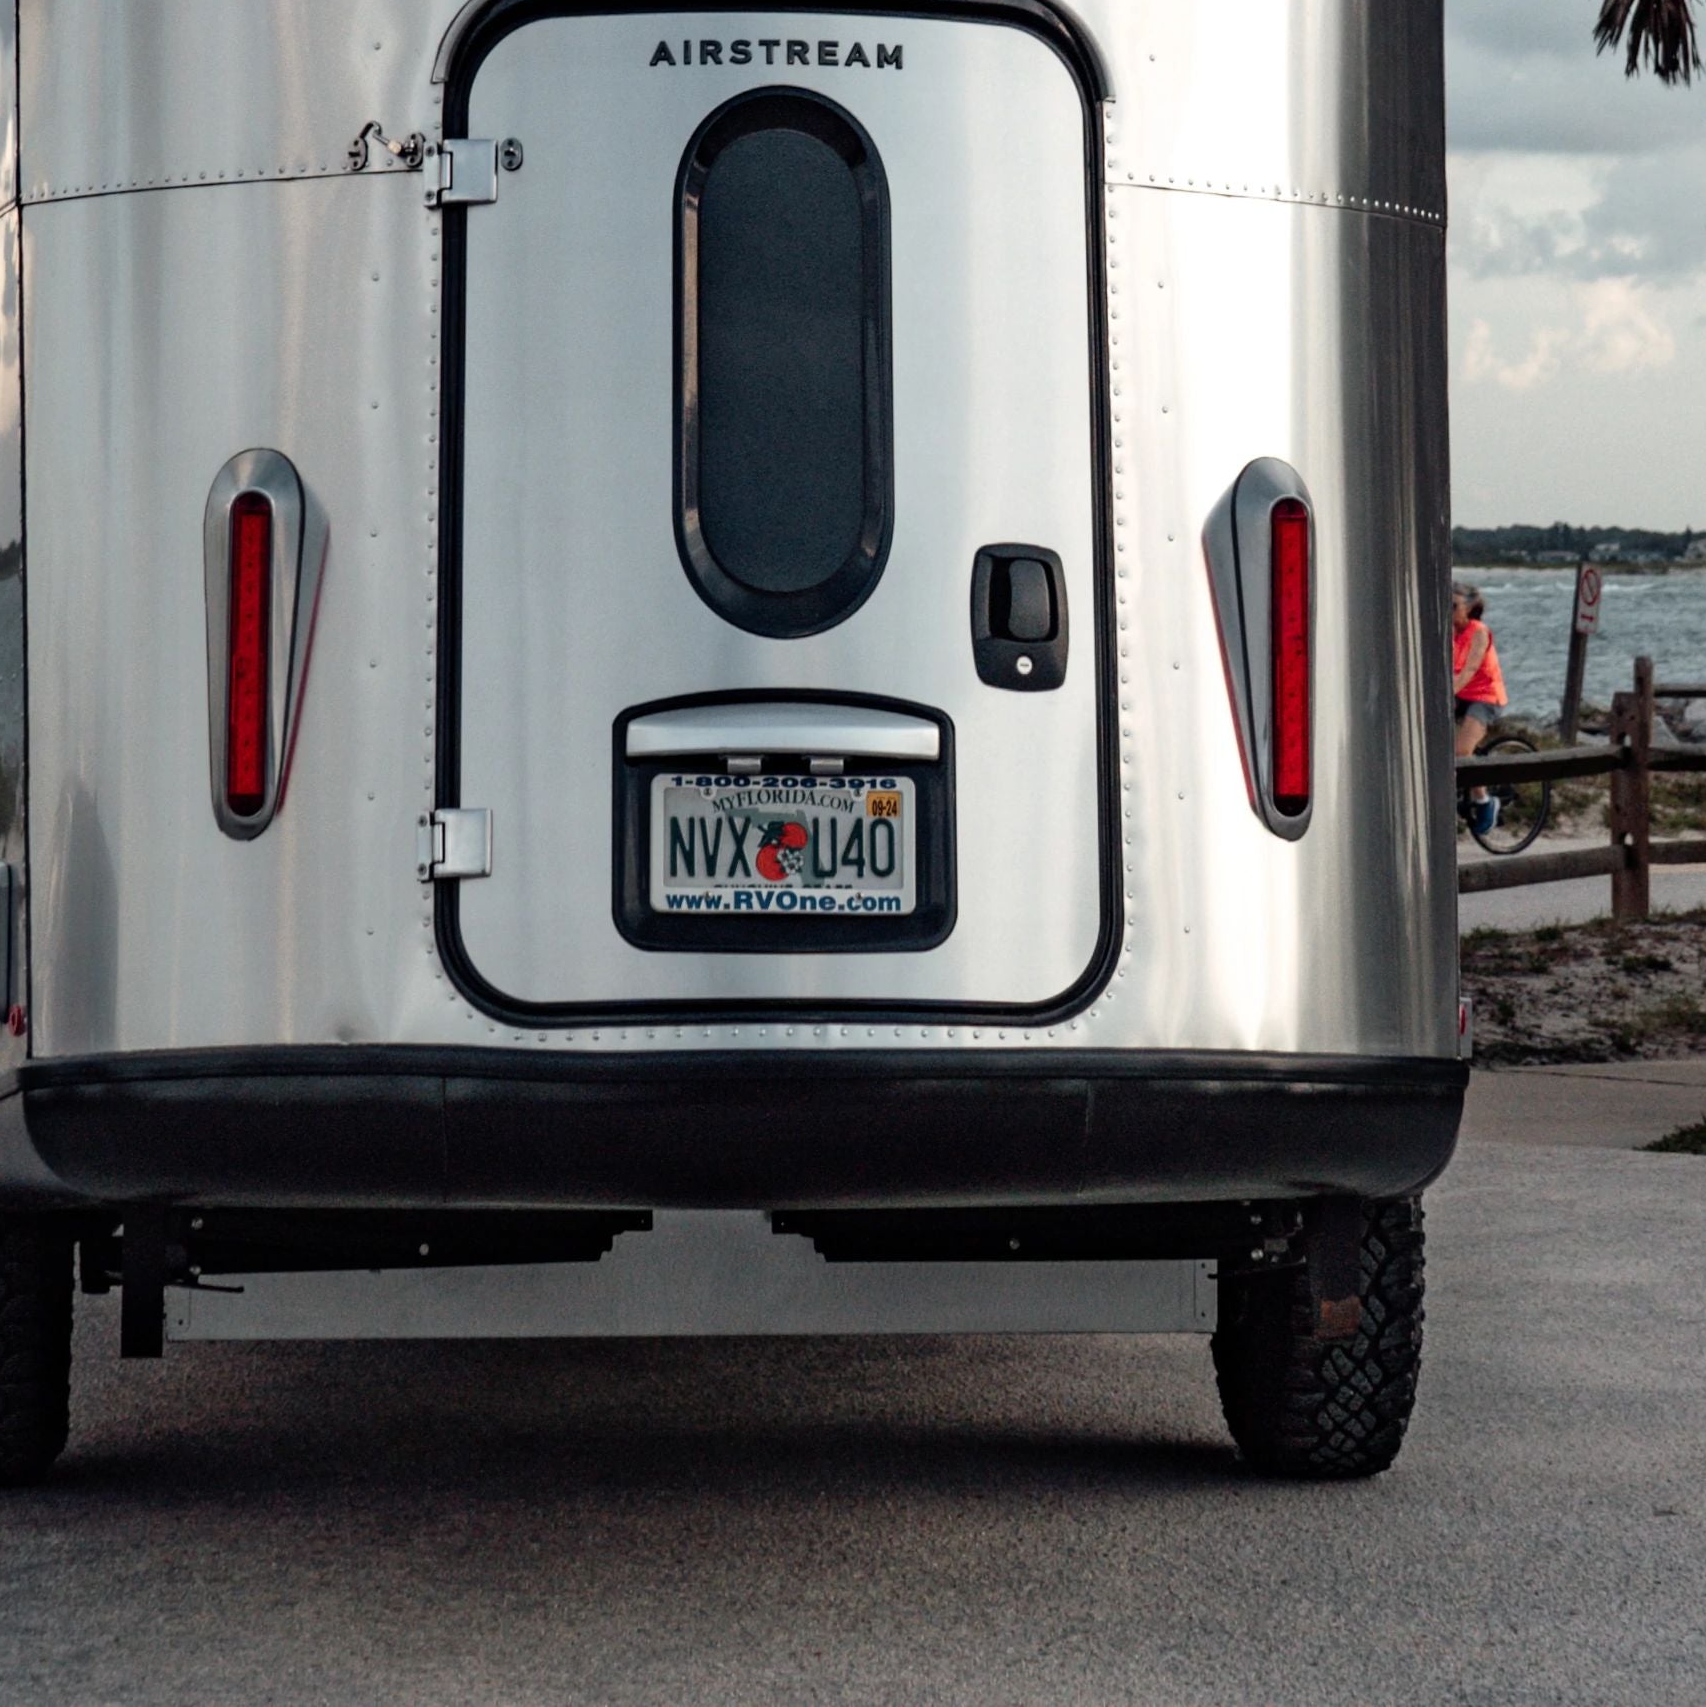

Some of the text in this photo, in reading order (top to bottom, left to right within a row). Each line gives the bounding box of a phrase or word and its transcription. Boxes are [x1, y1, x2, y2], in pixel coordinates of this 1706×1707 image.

[649, 39, 903, 69] AIRSTREAM
[671, 776, 897, 789] 1-800-206-3916
[712, 789, 856, 813] MYFLORIDA.COM
[871, 799, 898, 817] 09-24
[669, 816, 896, 878] NVX U40
[665, 890, 901, 912] www.RVOne.com
